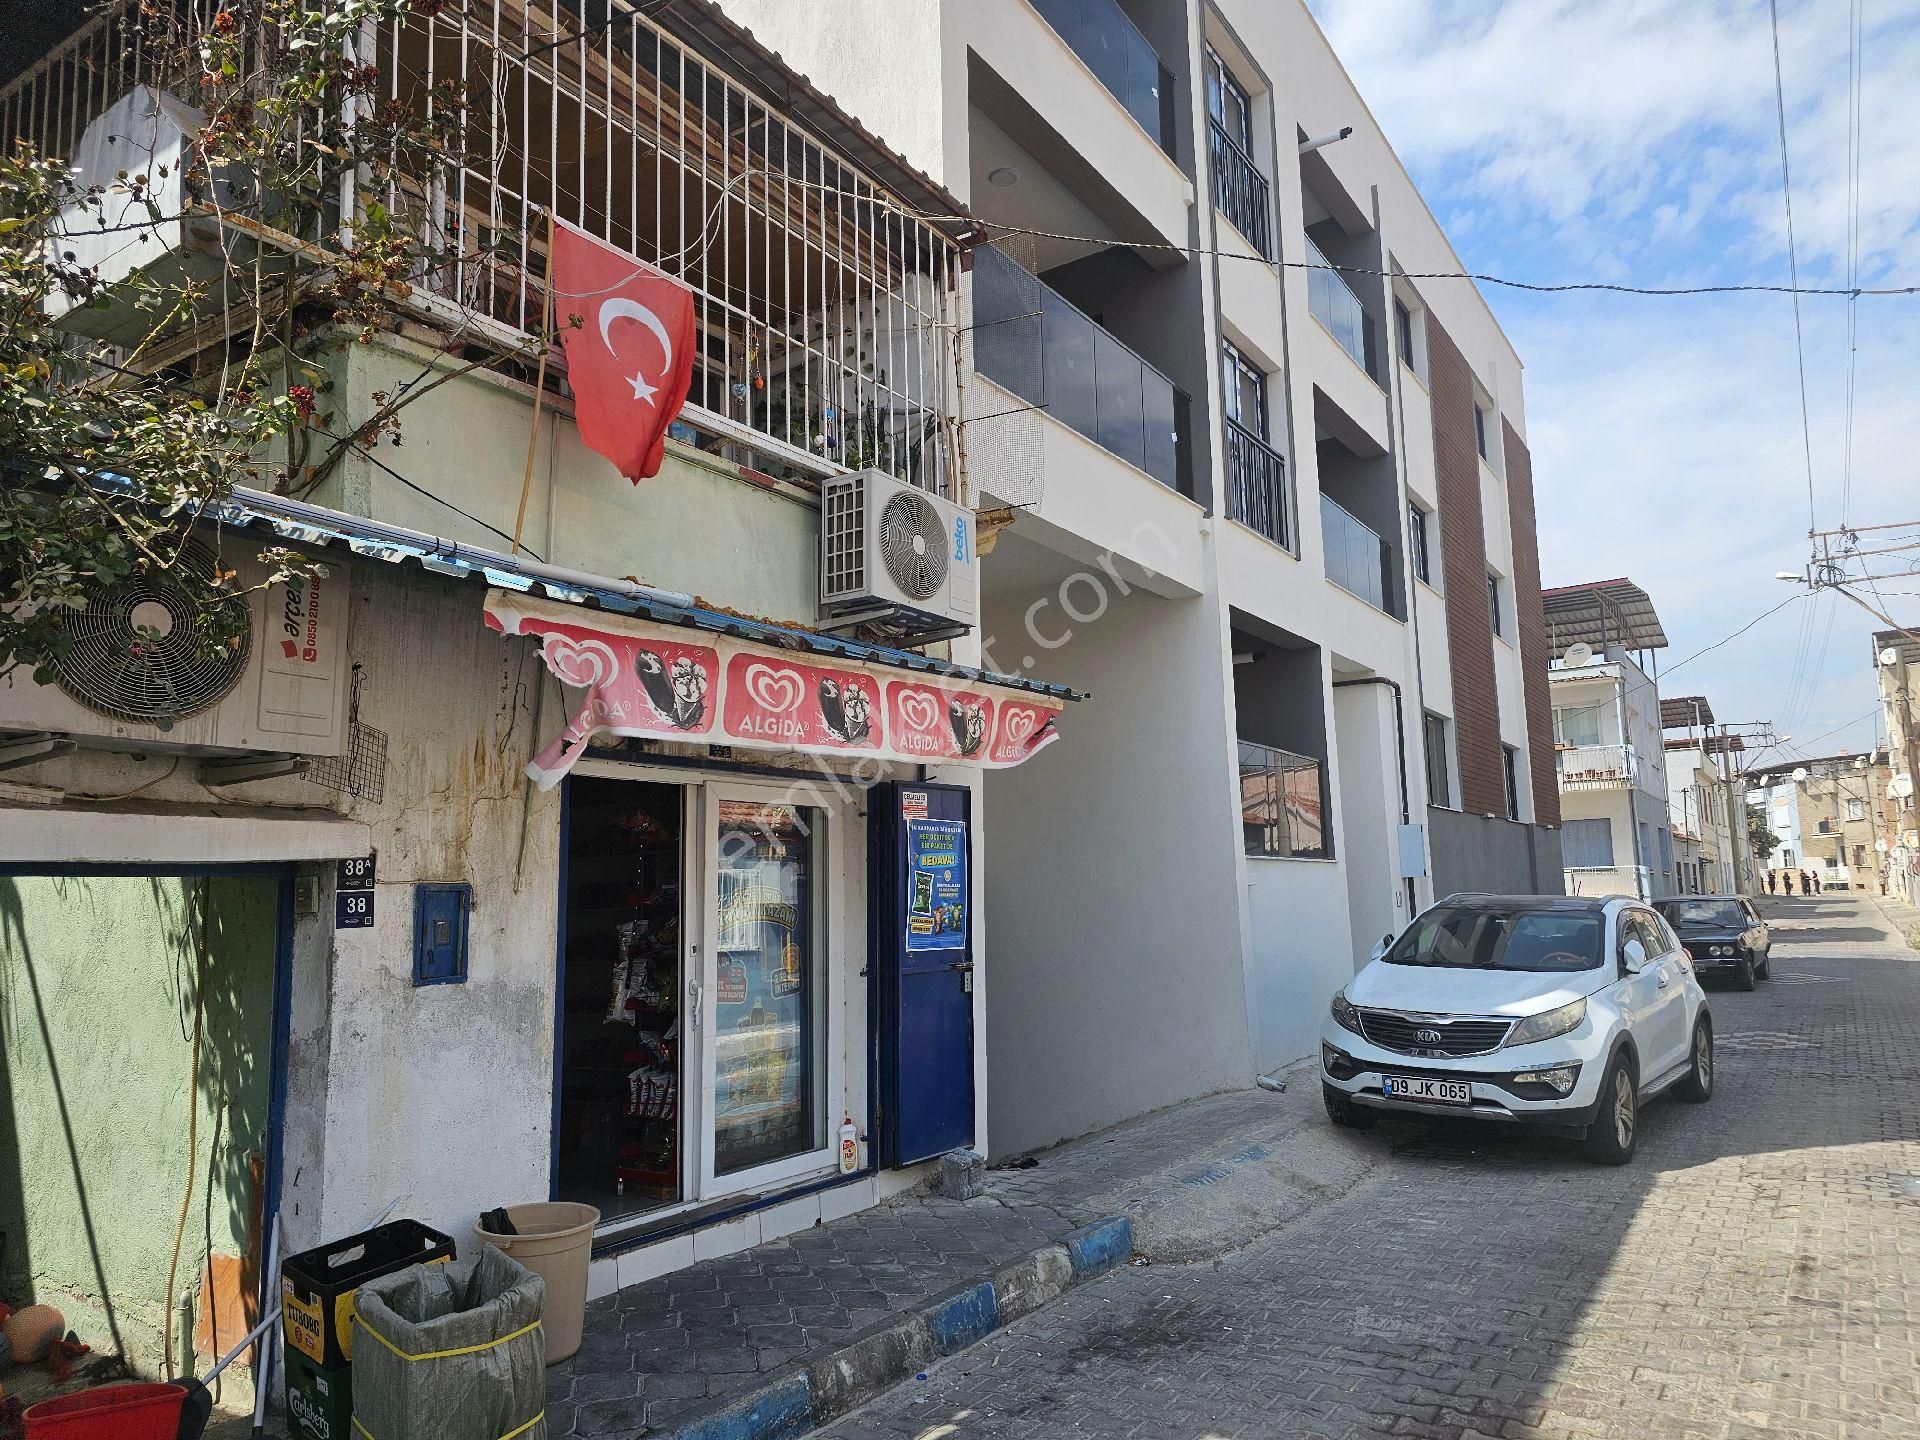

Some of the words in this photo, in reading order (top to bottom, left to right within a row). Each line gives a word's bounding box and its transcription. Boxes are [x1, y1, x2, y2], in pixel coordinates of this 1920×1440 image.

[954, 516, 965, 561] beko
[306, 619, 318, 647] 0850
[921, 854, 956, 866] BEDAVA!
[347, 897, 366, 914] 38
[1417, 1031, 1437, 1041] KIA
[1392, 1080, 1409, 1094] 09
[1415, 1081, 1435, 1096] JK
[1440, 1083, 1467, 1099] 065
[286, 1302, 320, 1337] TUBORG
[288, 1387, 330, 1440] Carlsberg
